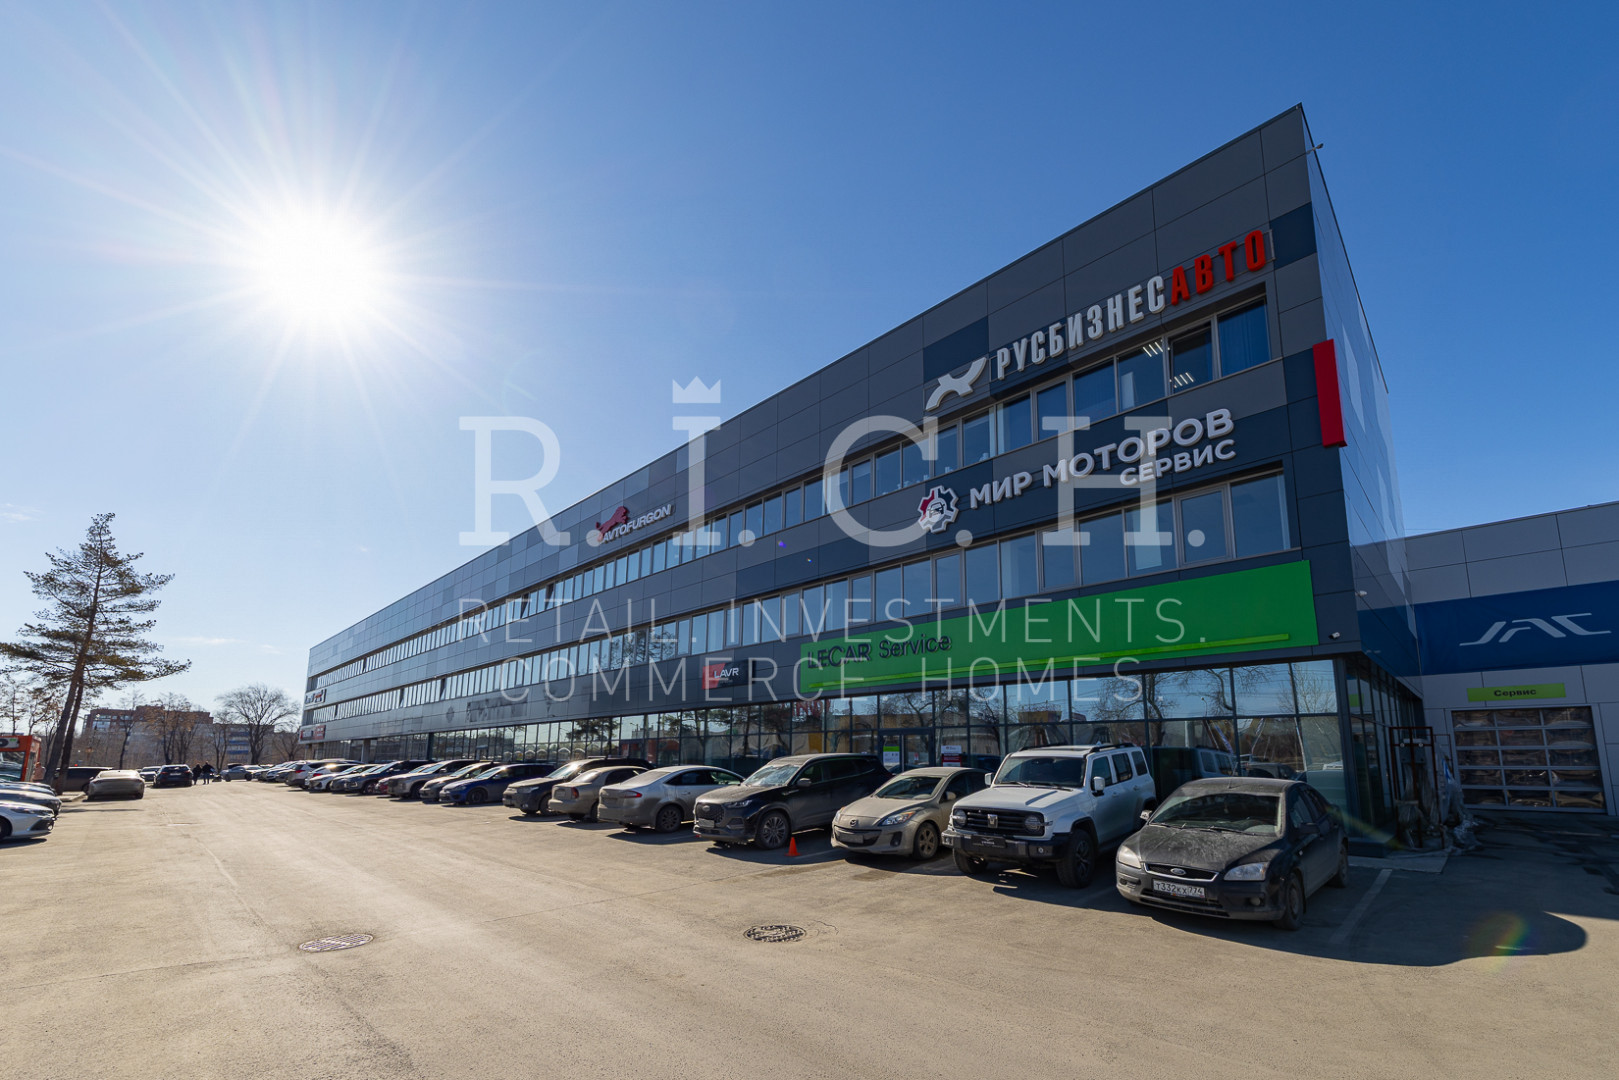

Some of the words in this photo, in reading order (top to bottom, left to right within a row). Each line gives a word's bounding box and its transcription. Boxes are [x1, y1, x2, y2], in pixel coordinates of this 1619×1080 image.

[997, 229, 1267, 380] РУСБИЗНЕСАВТО
[969, 471, 1033, 509] МИР
[1042, 408, 1235, 488] МОТОРОВ
[1119, 439, 1237, 486] СЕРВИС
[602, 504, 672, 543] AVTOFURGON
[807, 643, 870, 668] LECAR
[879, 633, 952, 658] Service
[714, 667, 739, 679] LAVR
[1494, 689, 1536, 698] Сервис
